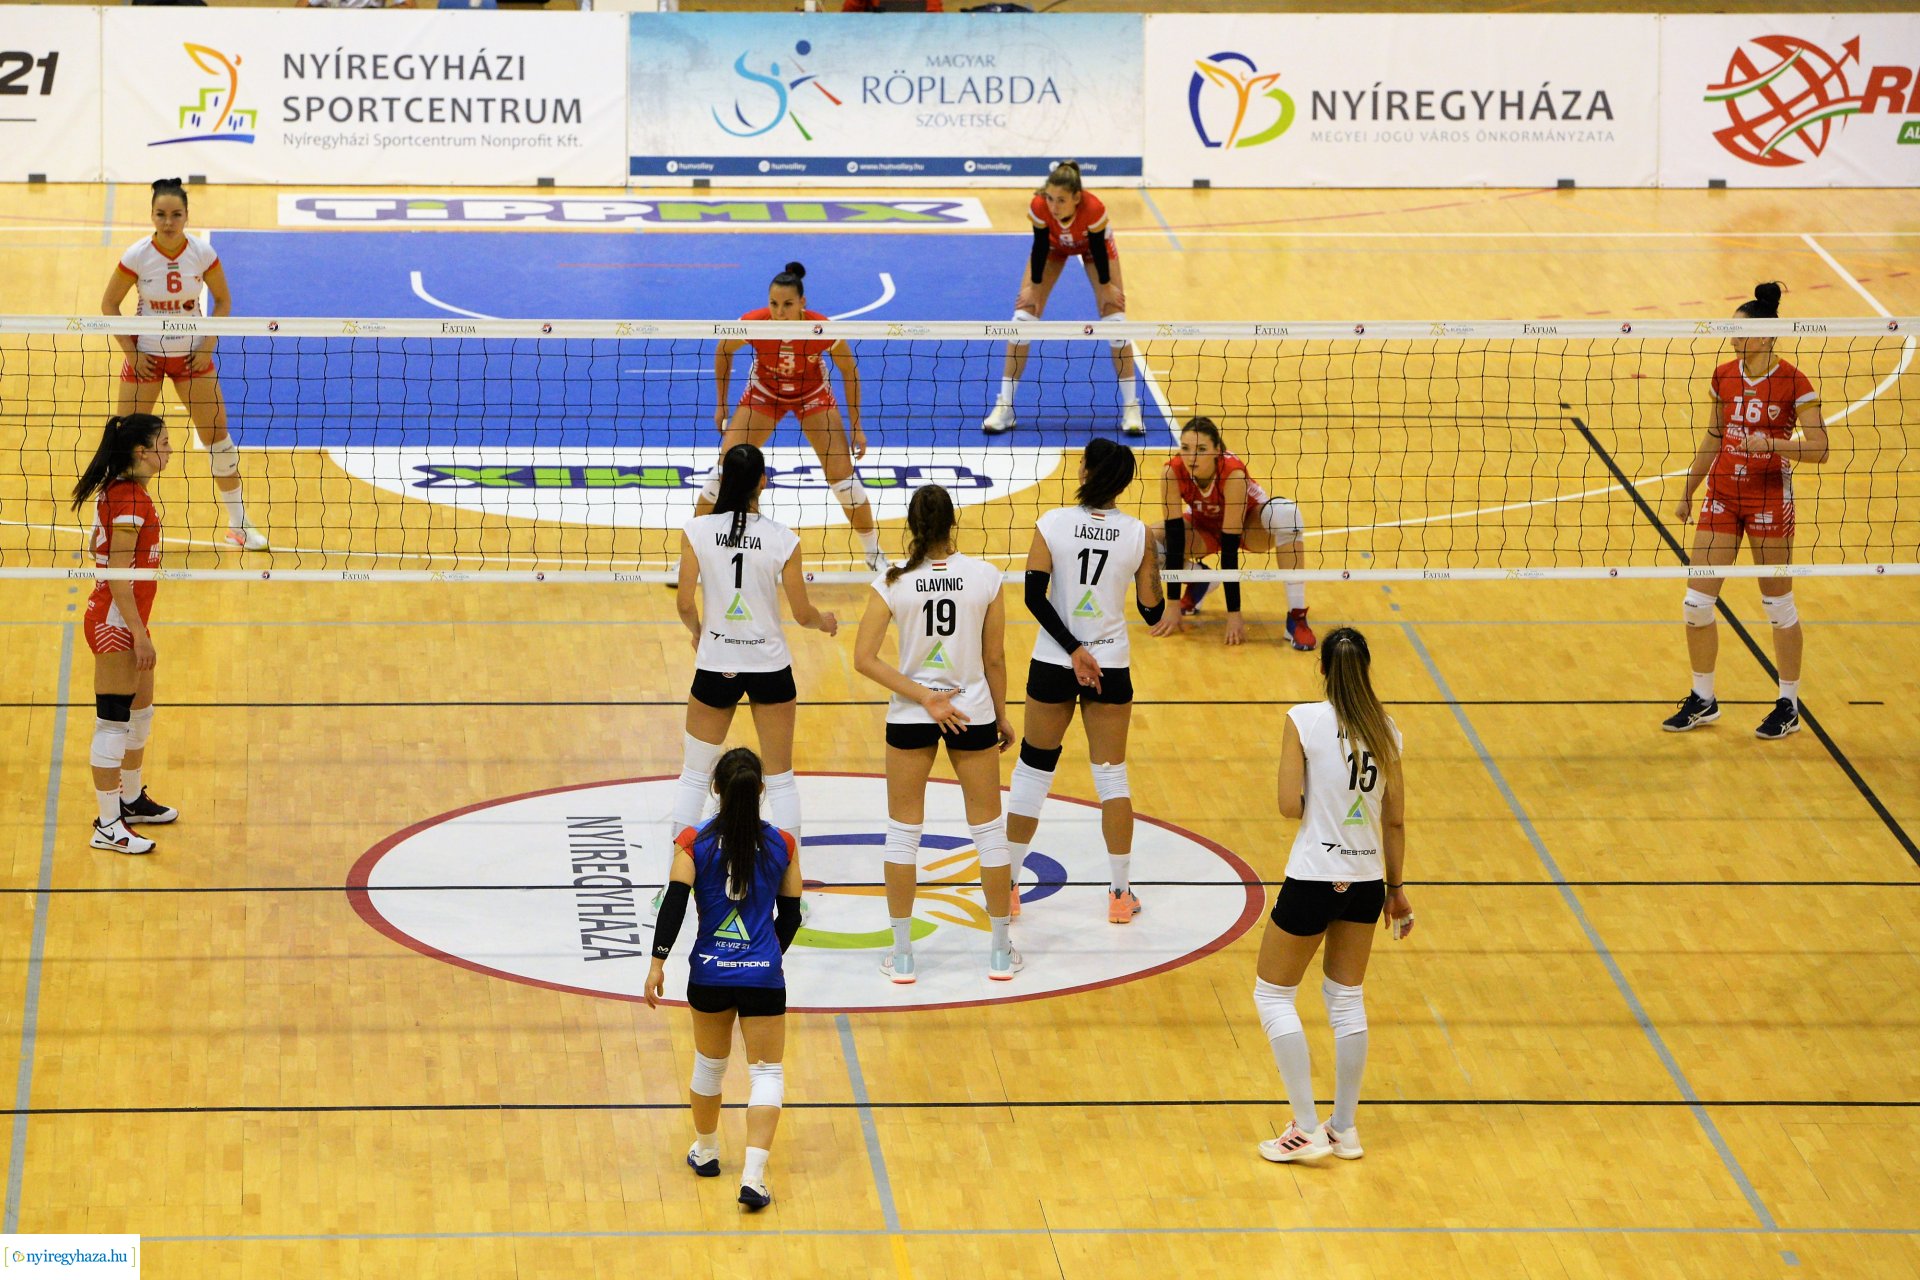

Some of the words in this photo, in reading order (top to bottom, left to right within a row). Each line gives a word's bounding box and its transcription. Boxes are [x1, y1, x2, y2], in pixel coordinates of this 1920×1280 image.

[283, 48, 525, 81] NYÍREGYHÁZI
[925, 54, 997, 69] MAGYAR
[0, 51, 59, 95] 21
[862, 70, 1063, 105] RÖPLABDA
[1859, 66, 1920, 113] R
[1311, 82, 1616, 121] NYÍREGYHÁZA
[283, 97, 582, 124] SPORTCENTRUM
[915, 112, 1007, 128] SZÖVETSÉG
[283, 132, 370, 149] Nyíregyházi
[374, 132, 477, 149] Sportcentrum
[481, 131, 553, 149] Nonprofit
[557, 131, 583, 147] Kft.
[1310, 131, 1368, 143] MEGYEI
[1374, 129, 1414, 143] JOGÚ
[1420, 129, 1470, 143] VÁROS
[1476, 129, 1616, 143] ÖNKORMÁNYZATA
[166, 271, 182, 293] 6
[162, 320, 197, 331] FATUM
[441, 322, 476, 334] FATUM
[713, 324, 748, 335] FATUM
[984, 325, 1019, 336] FATUM
[1254, 325, 1289, 336] FATUM
[1523, 324, 1558, 335] FATUM
[1793, 322, 1828, 333] FATUM
[1731, 396, 1763, 423] 16
[731, 553, 744, 588] 1
[1078, 548, 1109, 585] 17
[915, 577, 964, 593] GLAVINIC
[923, 599, 957, 637] 19
[724, 638, 766, 646] BESTRONG
[1347, 751, 1378, 793] 15
[1340, 848, 1377, 856] BESTRONG
[566, 816, 656, 962] NYÍREGYHÁZA
[715, 940, 741, 949] KE-VIZ
